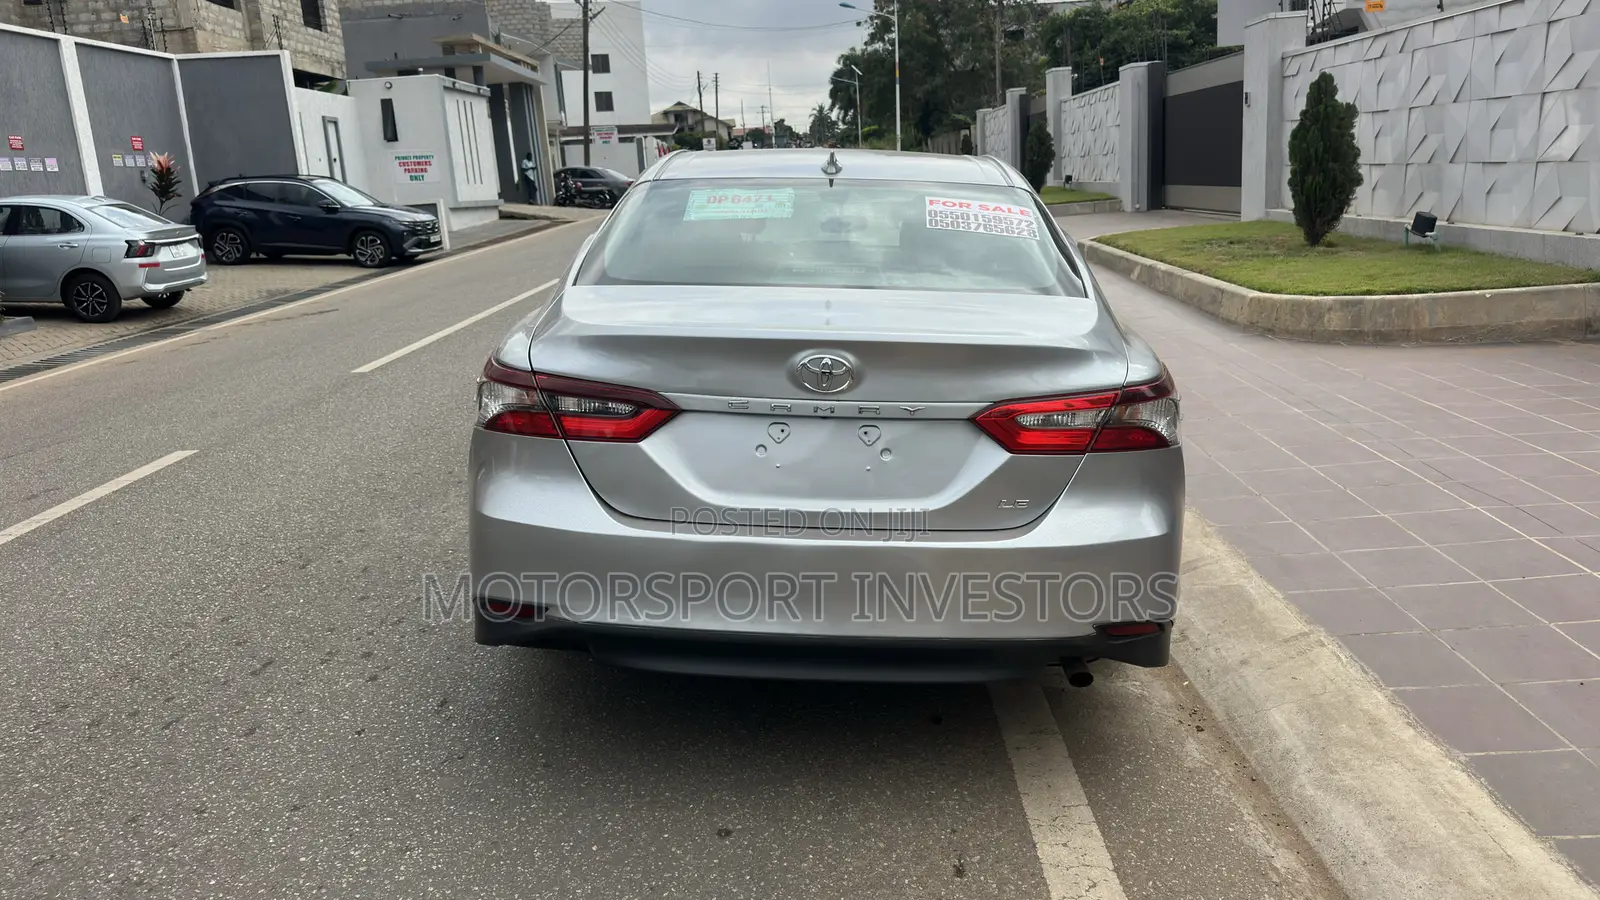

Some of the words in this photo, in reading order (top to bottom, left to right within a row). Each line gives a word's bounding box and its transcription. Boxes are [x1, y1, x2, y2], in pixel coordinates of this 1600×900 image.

[398, 160, 432, 168] CUSTOMERS
[409, 174, 425, 182] ONLY
[928, 199, 972, 209] FOR
[978, 204, 1032, 217] SALE
[927, 209, 1035, 229] 0550159572
[728, 400, 926, 416] CAMRY
[997, 499, 1030, 509] LE
